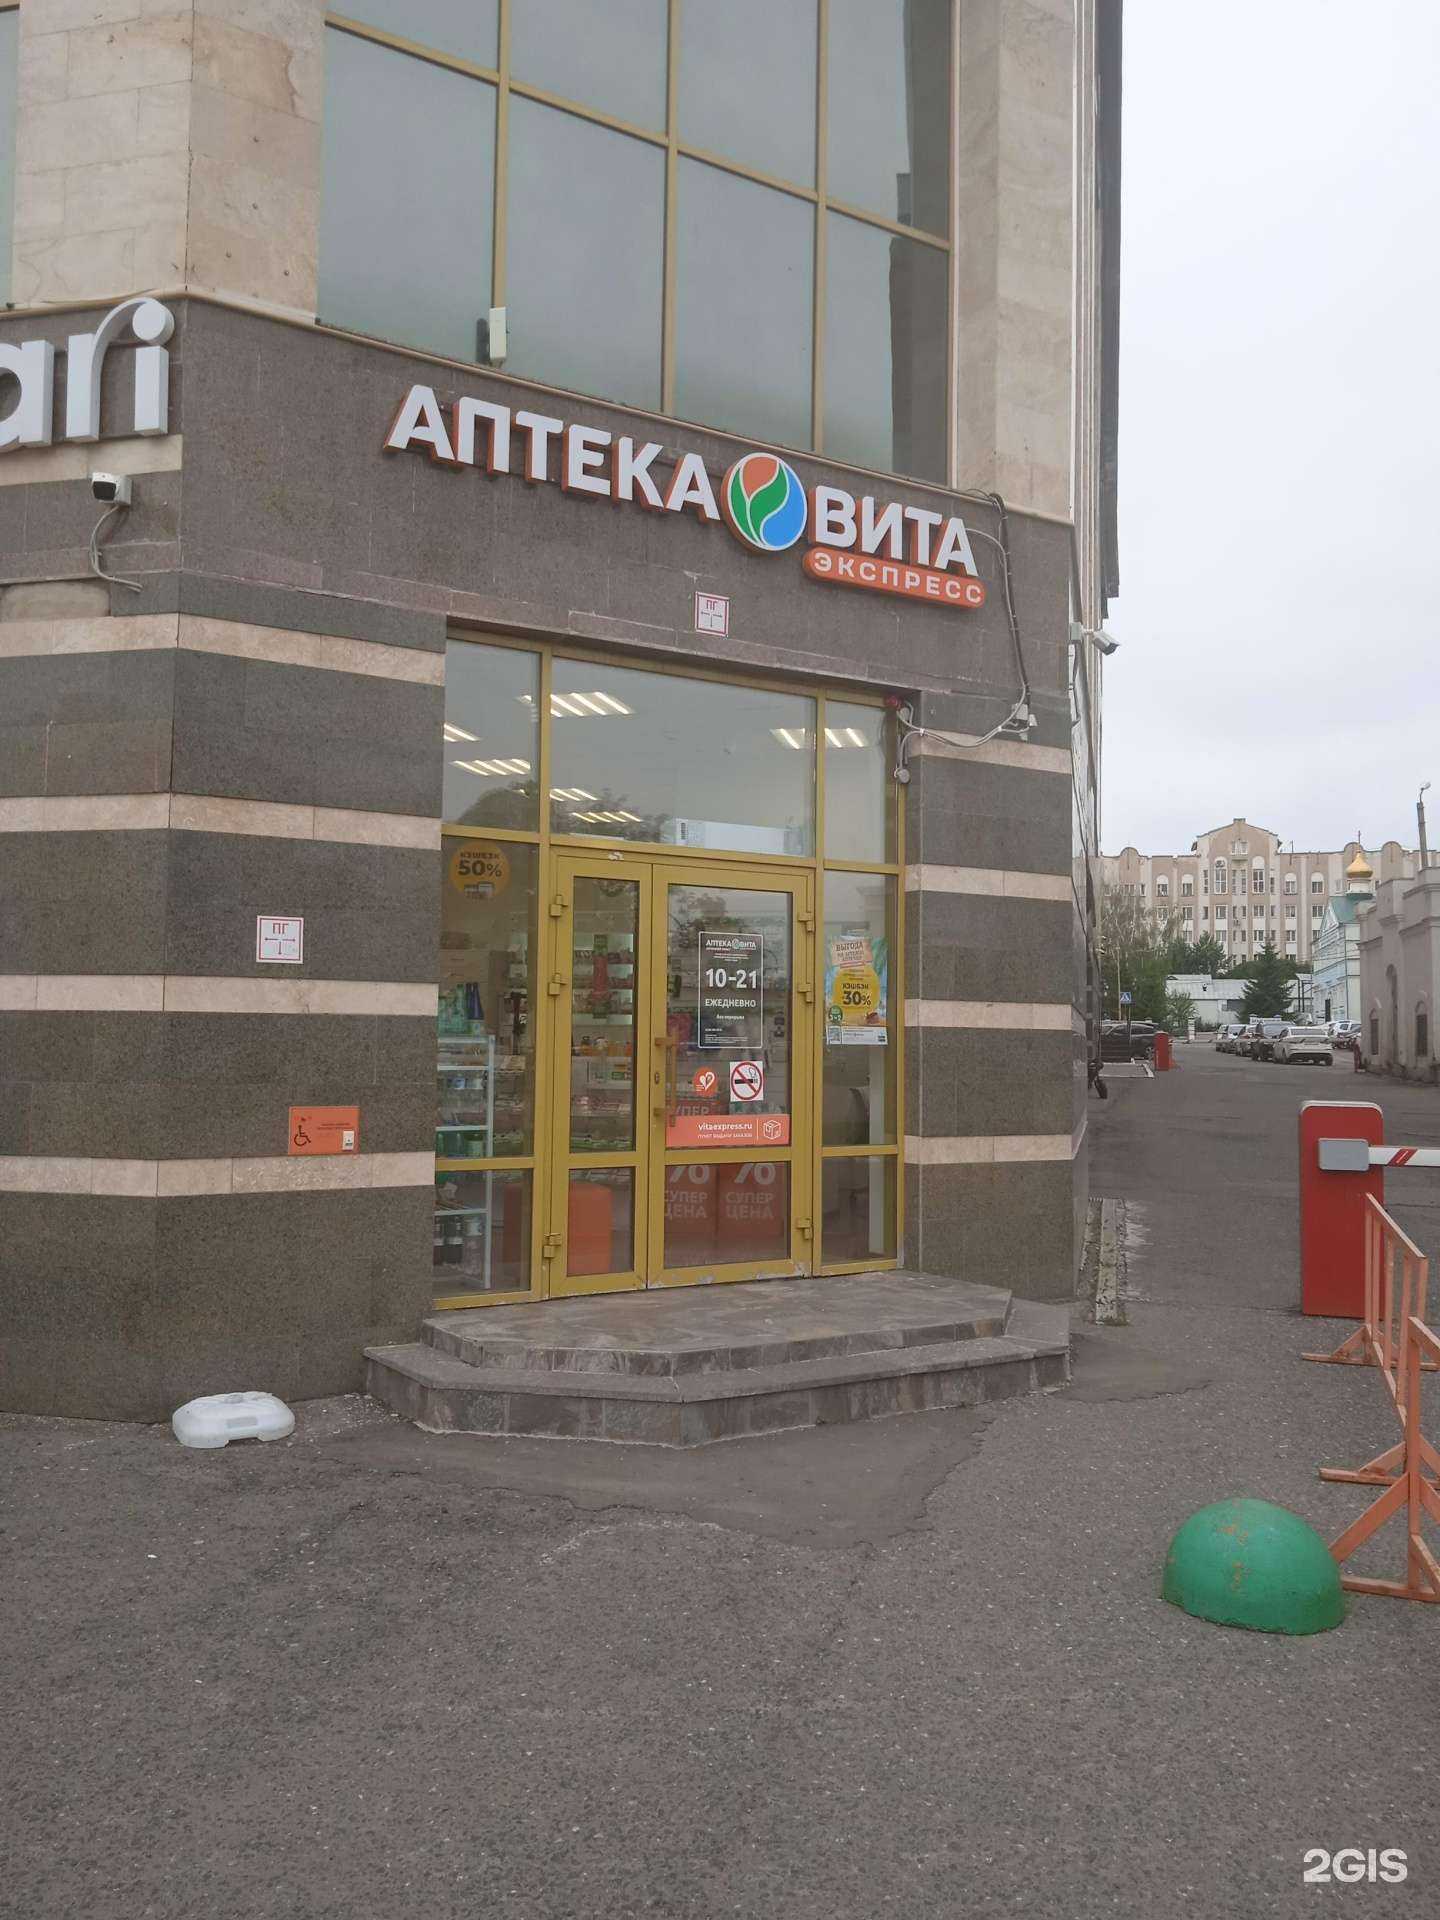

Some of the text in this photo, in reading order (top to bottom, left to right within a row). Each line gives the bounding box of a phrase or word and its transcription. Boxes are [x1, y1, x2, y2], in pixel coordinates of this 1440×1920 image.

[385, 384, 978, 577] АПТЕКА ВИТА
[813, 551, 981, 604] ЭКСПРЕСС
[458, 859, 502, 877] 50%
[272, 922, 290, 935] ПГ
[705, 939, 732, 948] АПТЕКА
[705, 968, 757, 989] 10-21
[705, 998, 757, 1009] ЕЖЕДНЕВНО
[842, 991, 872, 1006] 30%
[698, 1121, 753, 1133] vitaexpress.ru
